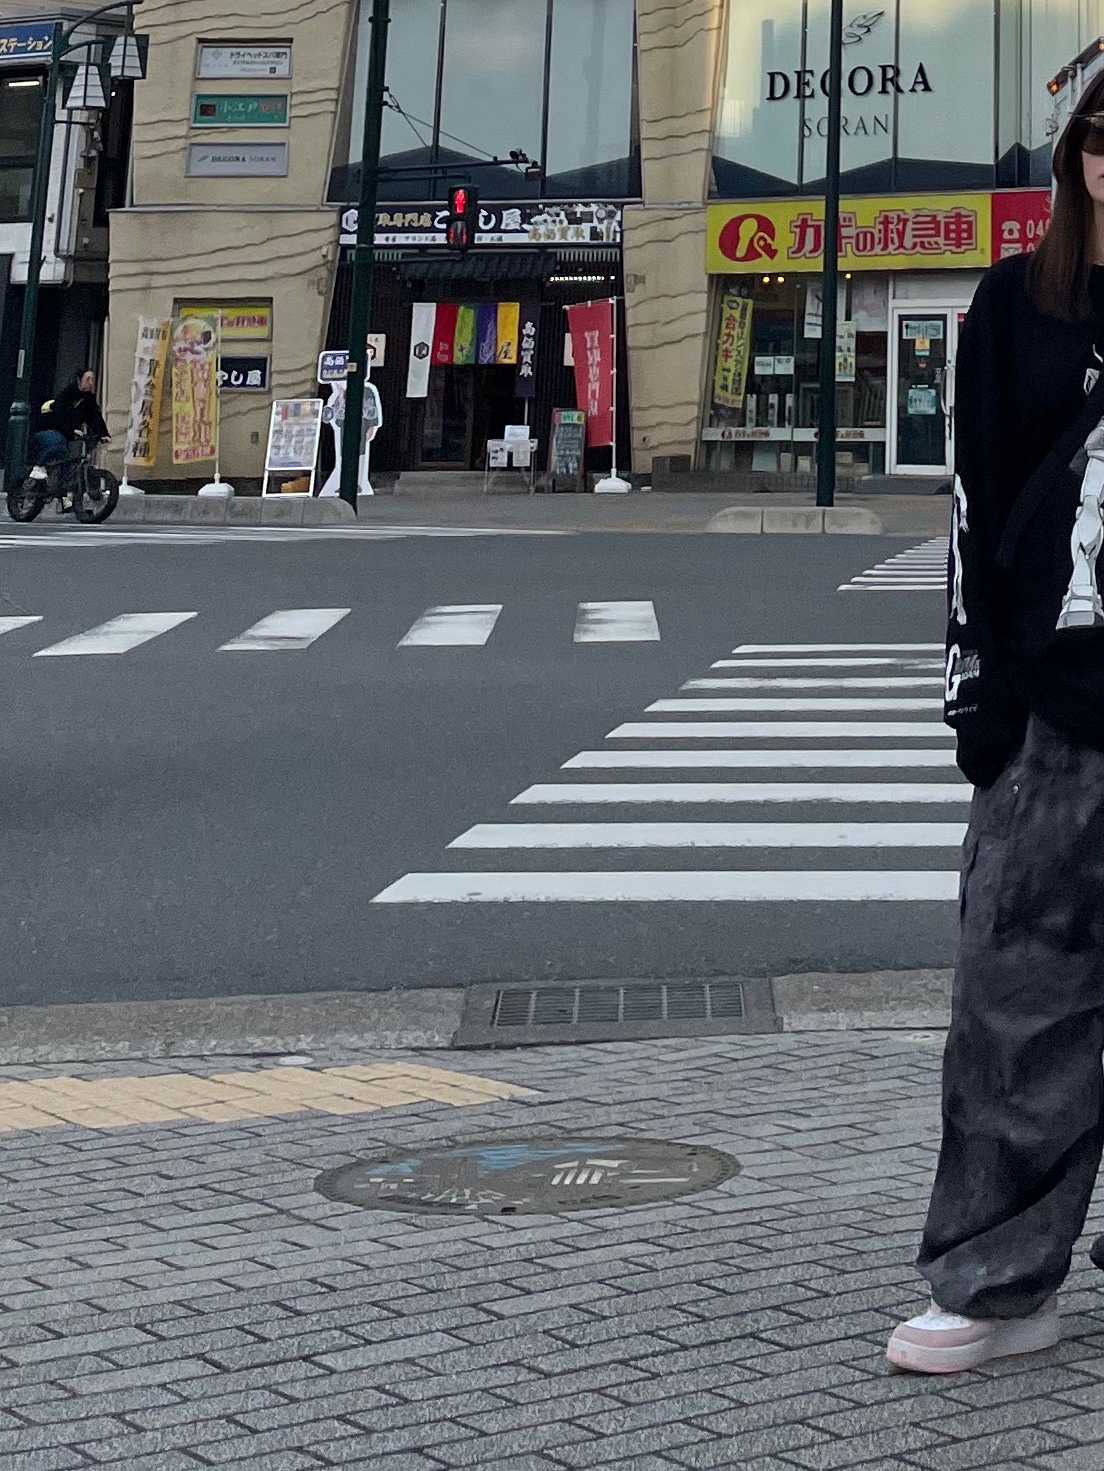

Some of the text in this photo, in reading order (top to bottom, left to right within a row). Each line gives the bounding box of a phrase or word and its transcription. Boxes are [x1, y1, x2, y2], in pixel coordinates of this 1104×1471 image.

[788, 210, 977, 259] カギの救急車
